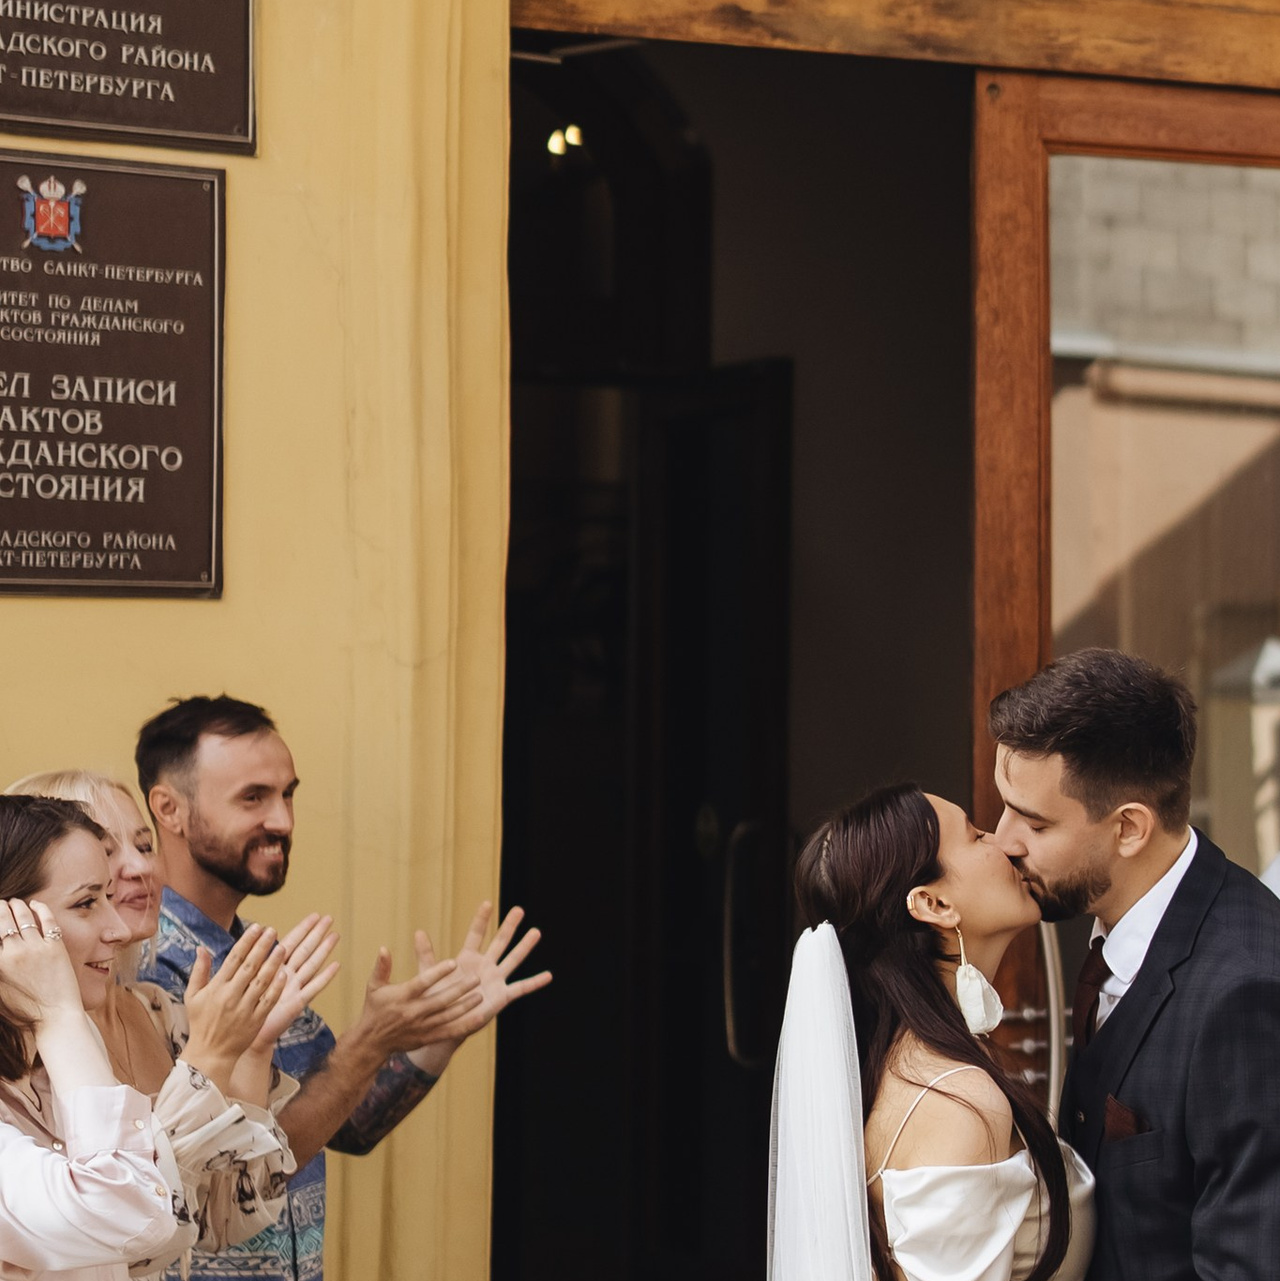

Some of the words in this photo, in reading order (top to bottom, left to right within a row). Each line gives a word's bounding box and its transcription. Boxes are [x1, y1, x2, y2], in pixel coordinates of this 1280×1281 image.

[121, 43, 215, 74] РАЙОНА
[43, 260, 204, 287] САНКТ-ПЕТЕРБУРГА
[48, 294, 71, 310] ПО
[79, 296, 139, 314] ДЕЛАМ
[0, 325, 101, 347] СОСТОЯНИЯ
[51, 311, 185, 335] ГРАЖДАНСКОГО
[51, 373, 177, 407] ЗАПИСИ
[0, 405, 103, 435] АКТОВ
[0, 439, 183, 472] ДАНСКОГО
[0, 472, 145, 503] СТОЯНИЯ
[103, 530, 177, 551] РАЙОНА
[0, 549, 142, 571] Т-ПЕТЕРБУРГА
